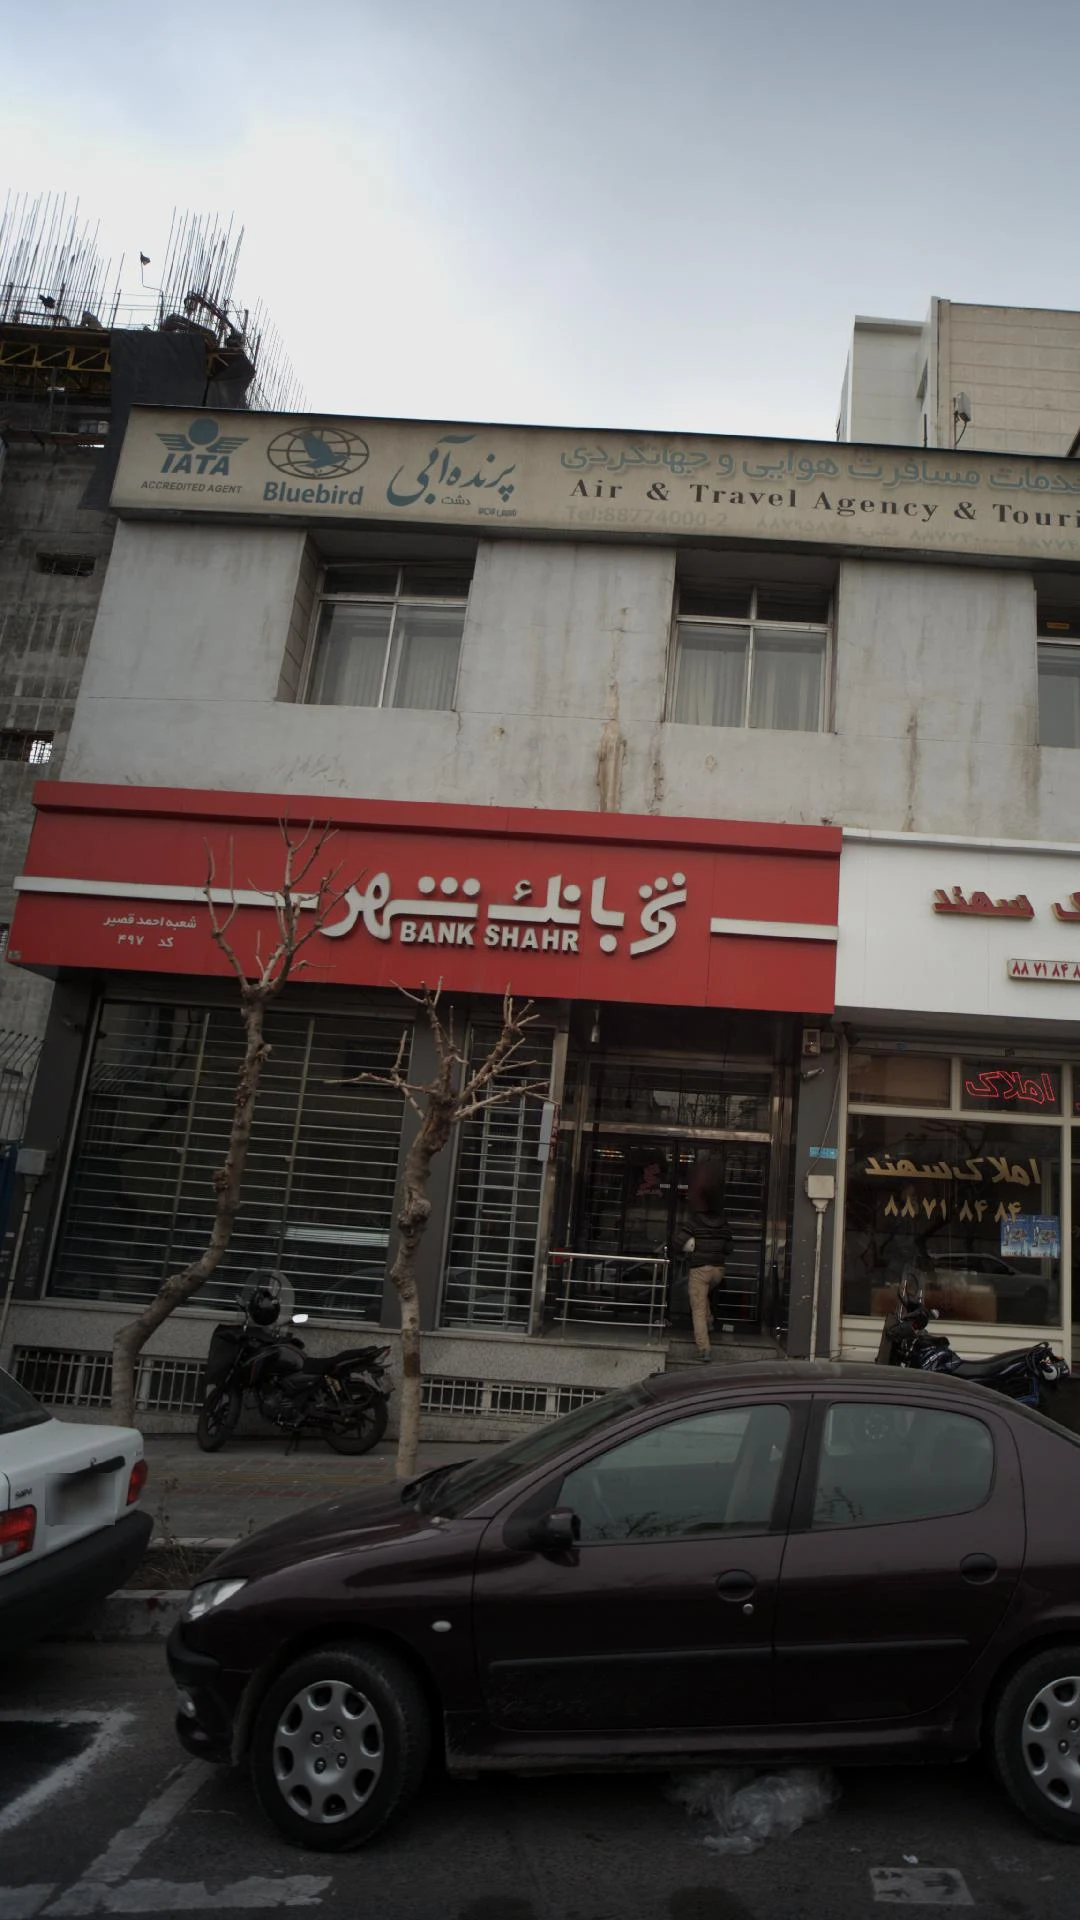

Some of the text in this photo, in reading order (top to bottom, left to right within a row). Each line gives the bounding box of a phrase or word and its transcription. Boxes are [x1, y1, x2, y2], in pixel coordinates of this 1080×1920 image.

[160, 452, 230, 476] IATA
[386, 433, 517, 507] پرنده آبی
[560, 443, 709, 475] جهانگردی
[715, 451, 735, 476] و
[742, 450, 839, 481] هوایی
[847, 453, 981, 488] مسافرت
[140, 480, 242, 494] ACCREDITED AGENT
[263, 481, 364, 506] Bluebird
[569, 479, 623, 498] Air
[646, 482, 671, 501] &
[689, 483, 797, 508] Travel
[812, 491, 939, 522] Agency
[954, 501, 978, 521] &
[319, 871, 625, 953] بانک شهر
[932, 886, 1035, 920] سهند
[102, 912, 196, 930] شعبه احمد قصیر
[116, 933, 174, 949] کد ۴۹۷
[400, 921, 580, 953] BANK SHAHR
[964, 1070, 1056, 1104] املاک
[864, 1153, 954, 1181] سهند
[954, 1156, 1042, 1186] املاک
